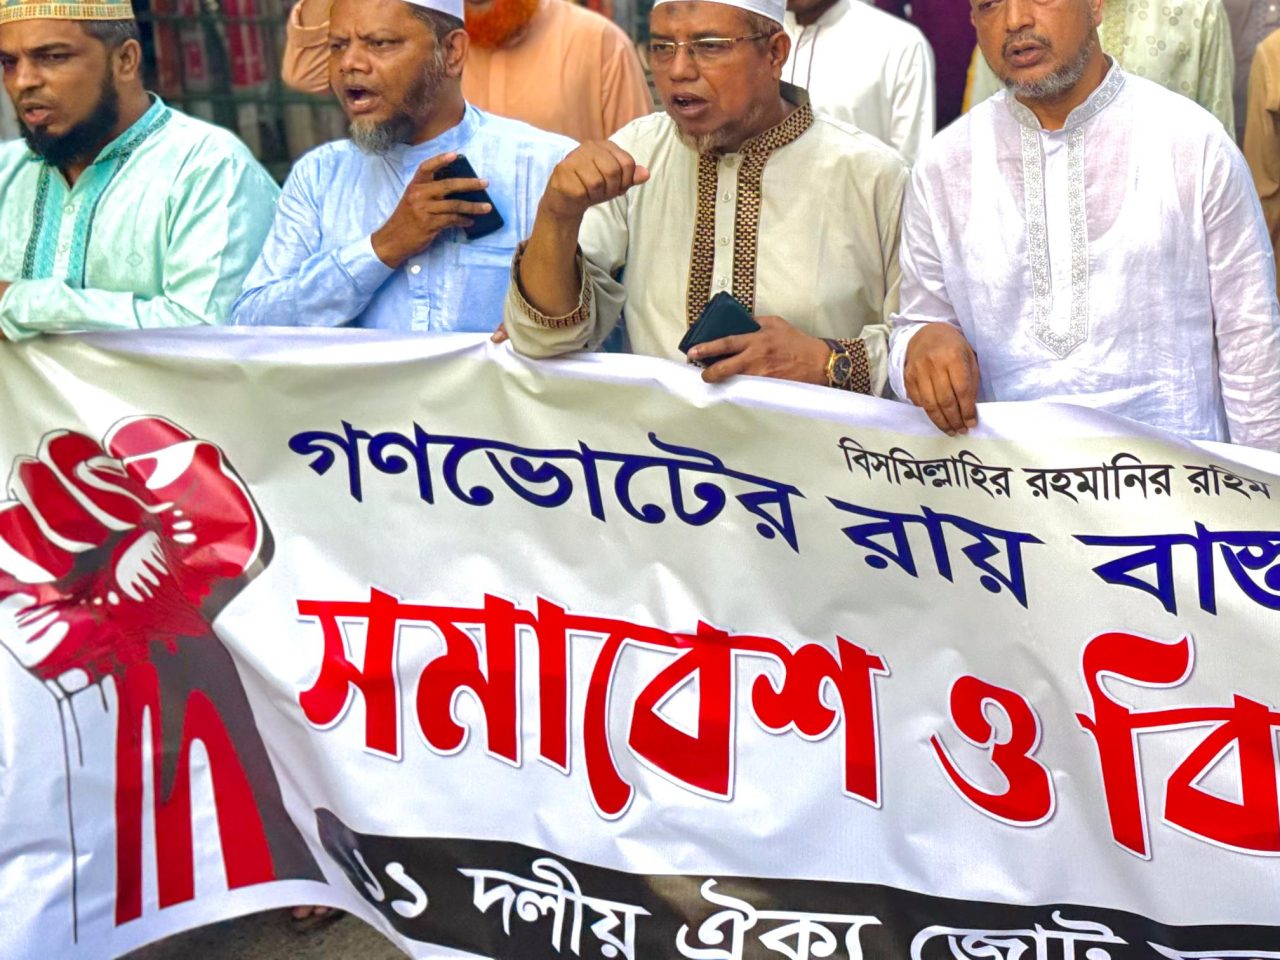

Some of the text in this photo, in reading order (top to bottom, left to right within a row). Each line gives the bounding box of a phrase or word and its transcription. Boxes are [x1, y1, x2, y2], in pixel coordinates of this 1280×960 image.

[288, 420, 804, 552] গণভোটের
[826, 495, 1044, 609] রায়
[838, 436, 1013, 499] বিসমিল্লাহির
[1022, 452, 1175, 500] রহমানির
[294, 585, 892, 824] সমাবেশ
[930, 672, 1058, 828] ও
[456, 857, 652, 960] দলীয়
[676, 877, 883, 960] ঐক্য
